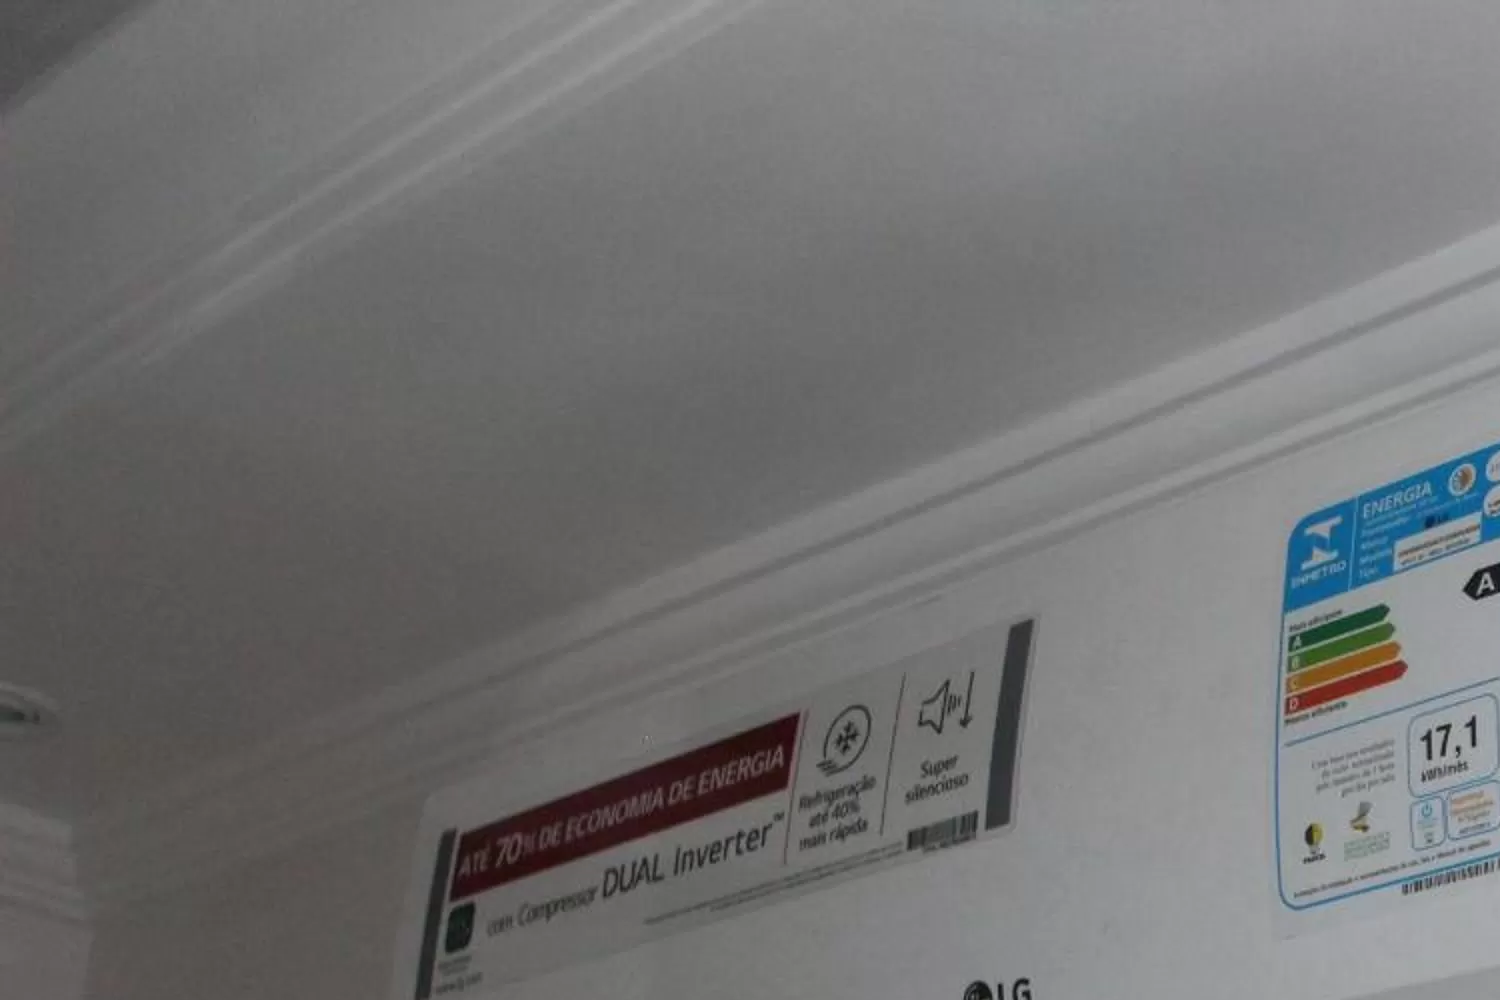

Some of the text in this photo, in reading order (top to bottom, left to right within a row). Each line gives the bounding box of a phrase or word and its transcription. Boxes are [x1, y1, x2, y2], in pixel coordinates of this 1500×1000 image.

[1363, 480, 1432, 519] ENERGIA
[1475, 572, 1495, 596] A
[1420, 714, 1478, 762] 17,1
[919, 754, 959, 780] Super
[799, 773, 878, 810] Refrigeração
[904, 772, 969, 806] silencioso
[458, 743, 785, 878] ATÉ 70% DE ECONOMIA DE ENERGIA
[831, 799, 861, 822] 40%
[829, 817, 869, 844] rápida
[517, 885, 599, 924] Compressor
[602, 853, 666, 900] DUAL
